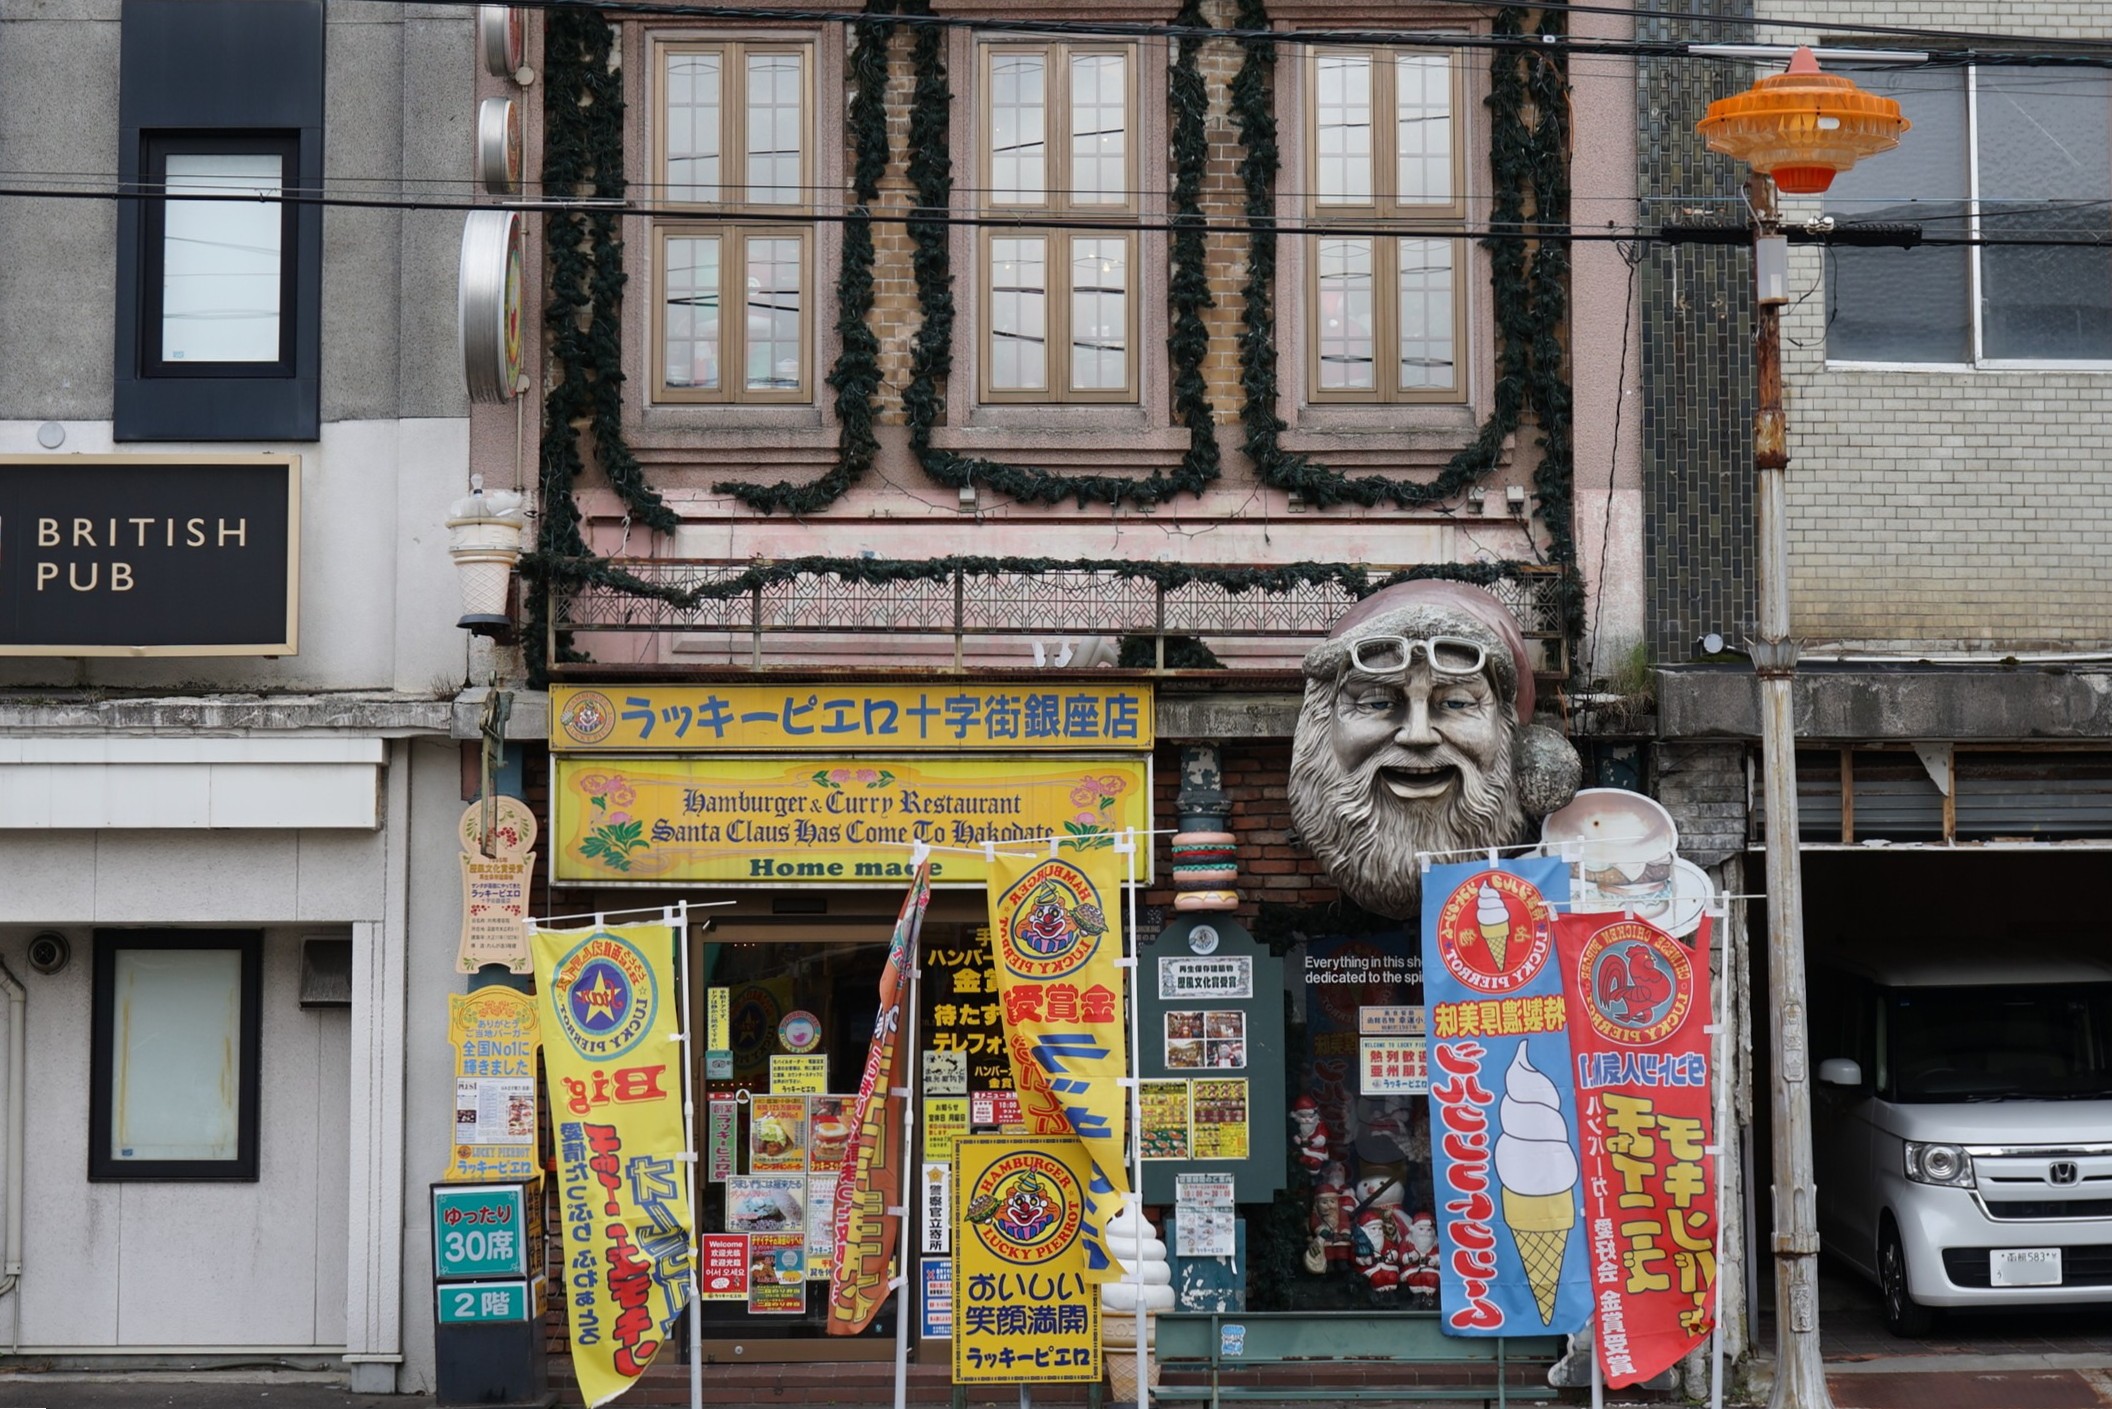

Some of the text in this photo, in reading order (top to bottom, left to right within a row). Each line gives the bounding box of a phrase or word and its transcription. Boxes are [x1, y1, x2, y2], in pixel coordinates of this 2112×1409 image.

[37, 517, 247, 548] BRITISH
[37, 562, 136, 592] PUB
[621, 692, 1140, 740] ラッキーピエロ十字街銀座店
[682, 788, 1022, 819] Hamburger & Curry Restaurant
[651, 818, 1054, 848] Santa Claus Has Come To Hakodate
[750, 858, 843, 876] Home
[1304, 955, 1370, 970] Everything
[1370, 956, 1381, 968] in
[1383, 956, 1405, 968] this
[1305, 971, 1368, 984] dedicated
[1368, 972, 1382, 984] to
[1383, 971, 1403, 984] the
[465, 1029, 530, 1038] ご当地バーガー
[478, 1019, 519, 1029] ありがとう
[933, 1033, 1008, 1055] テレフォ
[463, 1059, 529, 1076] 輝きました
[974, 1065, 1013, 1077] ハンバー
[935, 1103, 959, 1111] お知らせ
[949, 1114, 966, 1122] 月曜日
[457, 1160, 532, 1174] ラッキーピエロ
[980, 1155, 1073, 1194] HAMBURGER
[444, 1205, 512, 1226] ゆったり
[929, 1184, 943, 1251] 警察官立寄所
[982, 1200, 1080, 1261] LUCKY PIERROT
[444, 1230, 514, 1263] 30席
[968, 1273, 1086, 1301] おいしい
[454, 1291, 510, 1318] 2階
[966, 1304, 1088, 1336] 笑顔満開
[966, 1345, 1091, 1369] ラッキーピエロ
